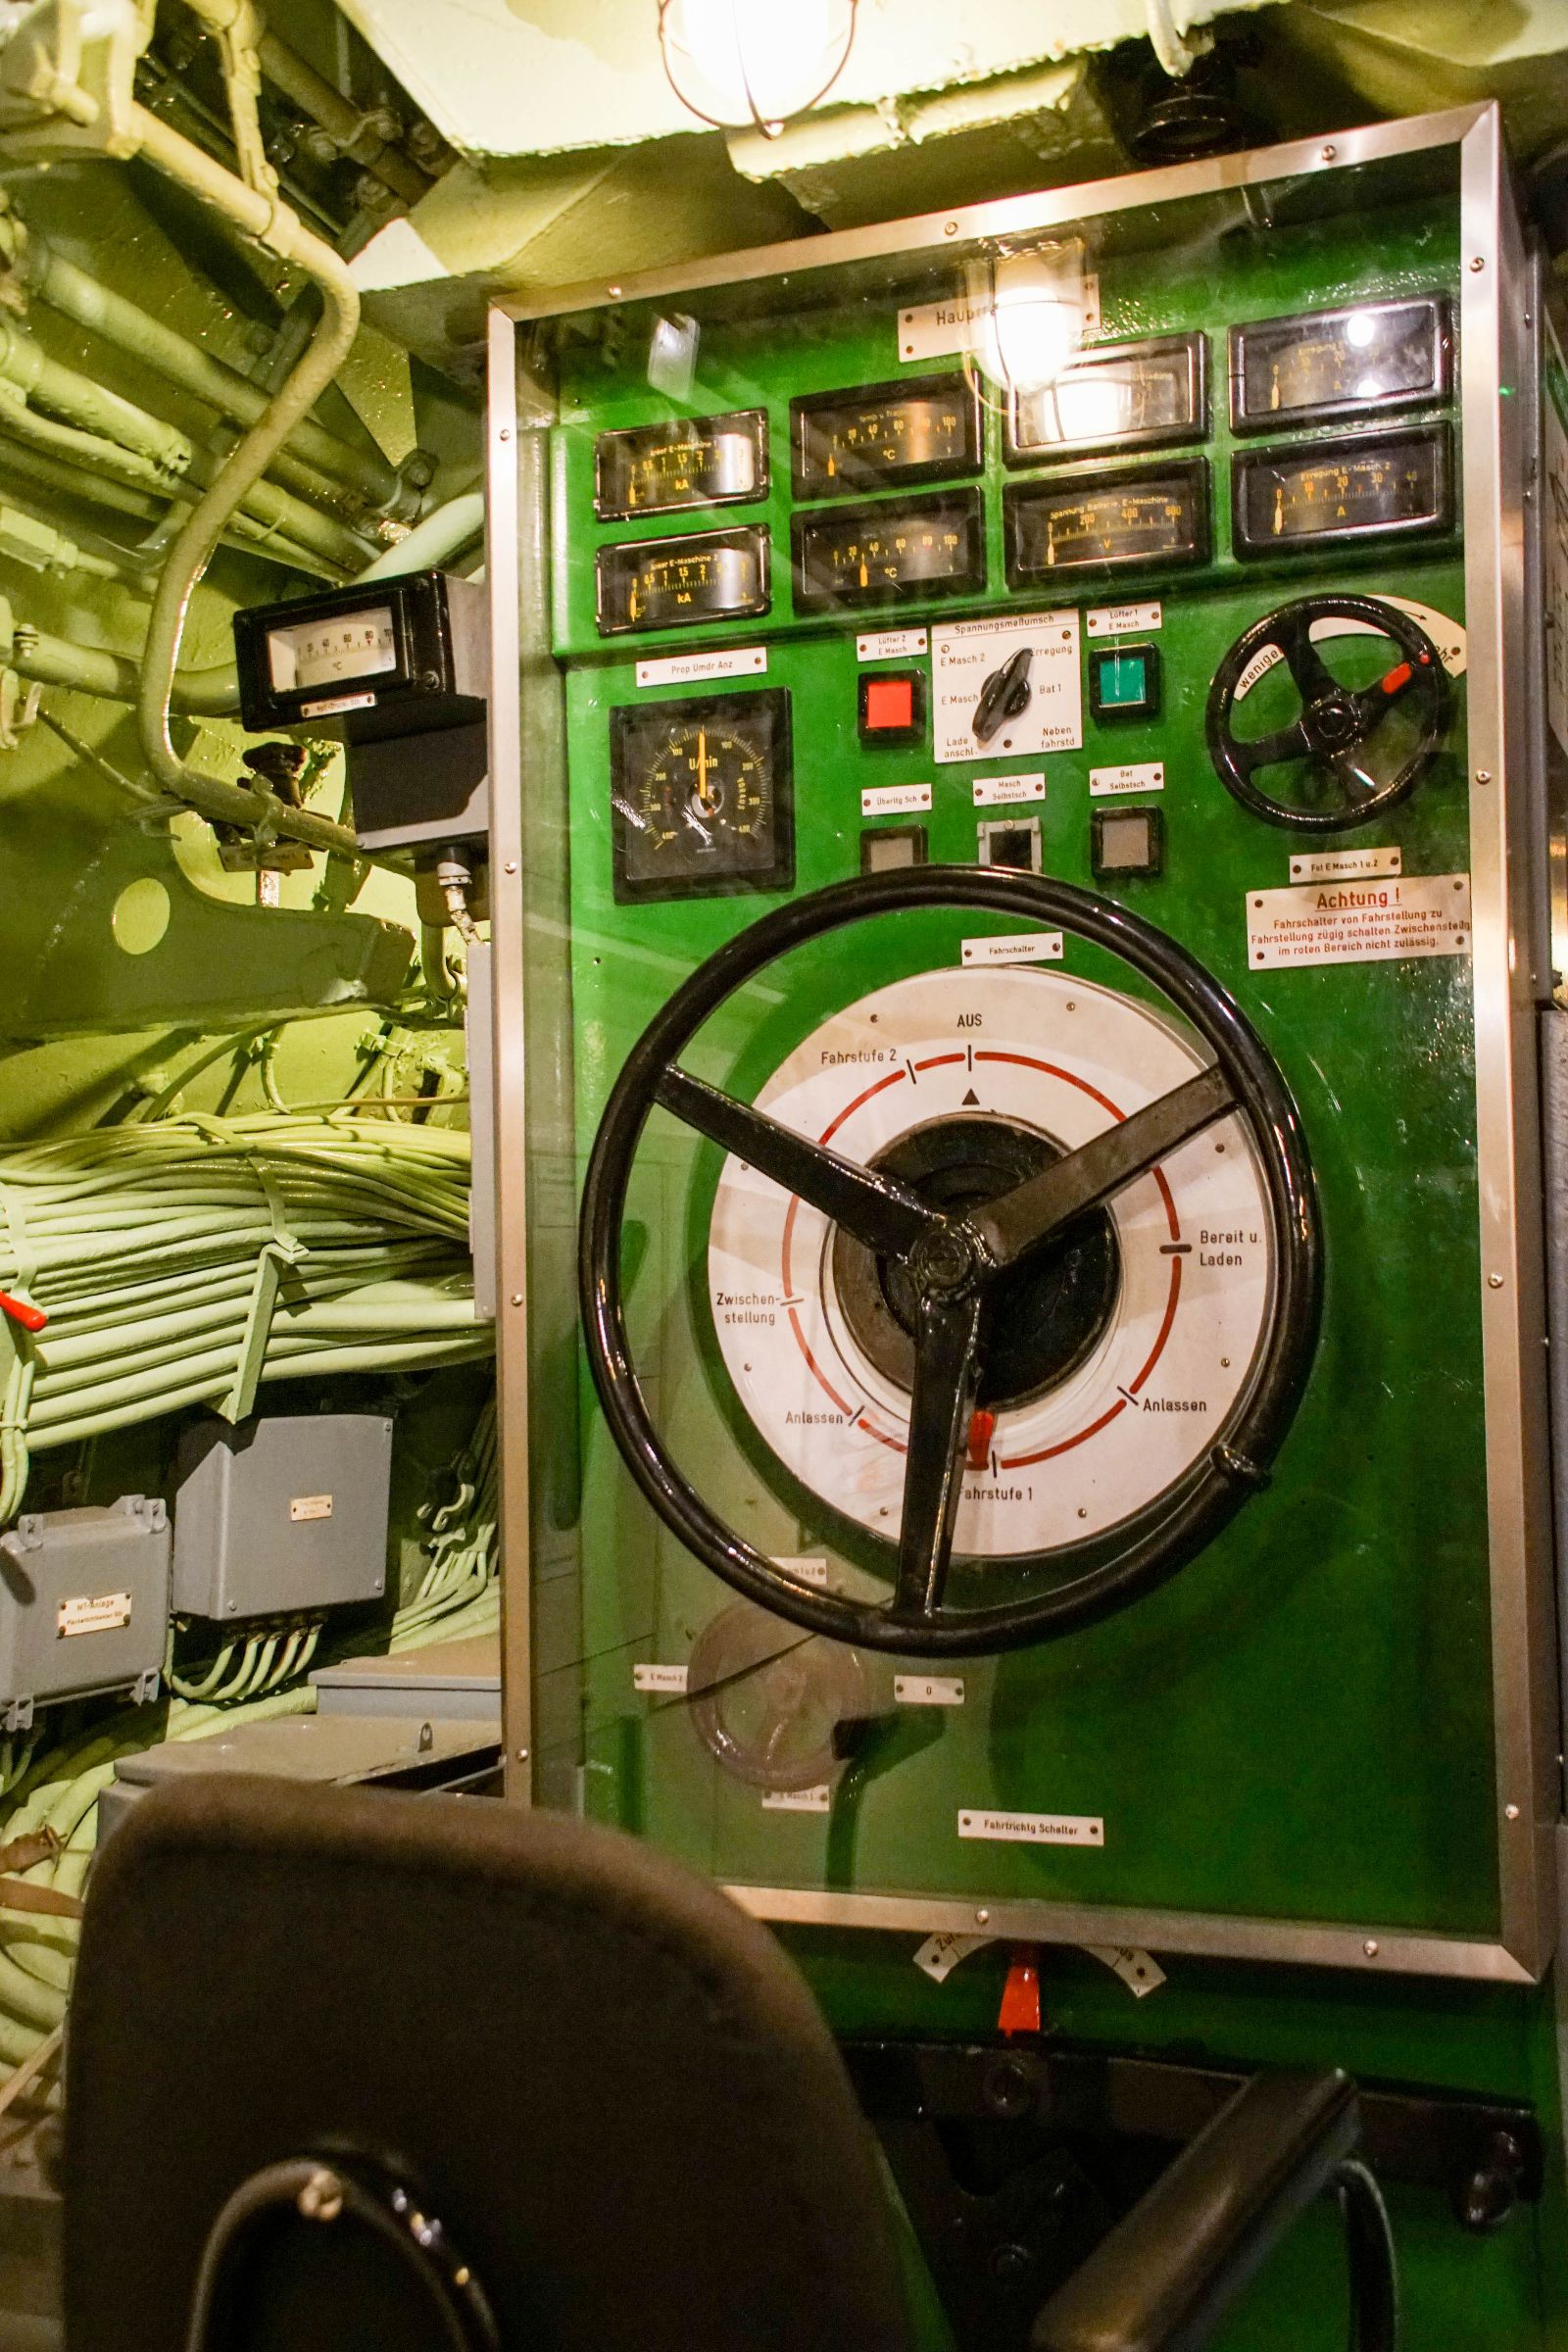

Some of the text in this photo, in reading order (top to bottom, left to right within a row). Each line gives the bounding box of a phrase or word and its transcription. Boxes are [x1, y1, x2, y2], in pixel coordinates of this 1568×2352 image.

[868, 424, 878, 434] 40
[675, 478, 689, 491] kA
[1276, 488, 1282, 500] 0
[1303, 481, 1314, 493] 10
[1337, 475, 1348, 488] 20
[1371, 471, 1383, 484] 30
[1080, 513, 1096, 526] 200
[1120, 507, 1138, 519] 400
[1164, 505, 1182, 517] 600
[1337, 506, 1346, 517] A
[868, 541, 879, 552] 40
[943, 534, 958, 546] 100
[669, 555, 711, 568] E-Maschine
[700, 564, 707, 575] 2
[884, 566, 897, 579] °C
[677, 591, 692, 605] kA
[955, 613, 1054, 635] Spannungsmeßumsch
[940, 653, 986, 667] E Masch 2
[1239, 647, 1283, 690] wenige
[1039, 684, 1055, 695] Bat
[941, 693, 979, 706] E Masch
[1042, 726, 1072, 737] Neben
[946, 736, 968, 748] Lade
[1041, 737, 1075, 749] fahrstd
[1332, 861, 1358, 870] Masch
[1316, 886, 1400, 909] Achtung !
[1273, 908, 1443, 930] Fahrschalter von Fahrstellung zu
[1250, 932, 1314, 946] Fahrstellung
[1317, 929, 1344, 941] zügig
[989, 945, 1036, 956] Fahrschalter
[1278, 936, 1440, 956] im roten Bereich nicht zulässig.
[956, 1012, 983, 1028] AUS
[821, 1048, 898, 1065] Fahrstufe 2
[1200, 1230, 1245, 1245] Bereit
[1200, 1251, 1243, 1266] Laden
[716, 1293, 781, 1306] Zwischen-
[724, 1311, 776, 1327] stellung
[1143, 1397, 1207, 1412] Anlassen
[785, 1411, 844, 1425] Anlassen
[962, 1486, 1033, 1500] ahrstufe 1
[926, 1685, 932, 1695] 0
[984, 1818, 1079, 1836] Fahrtrichtg Schalter
